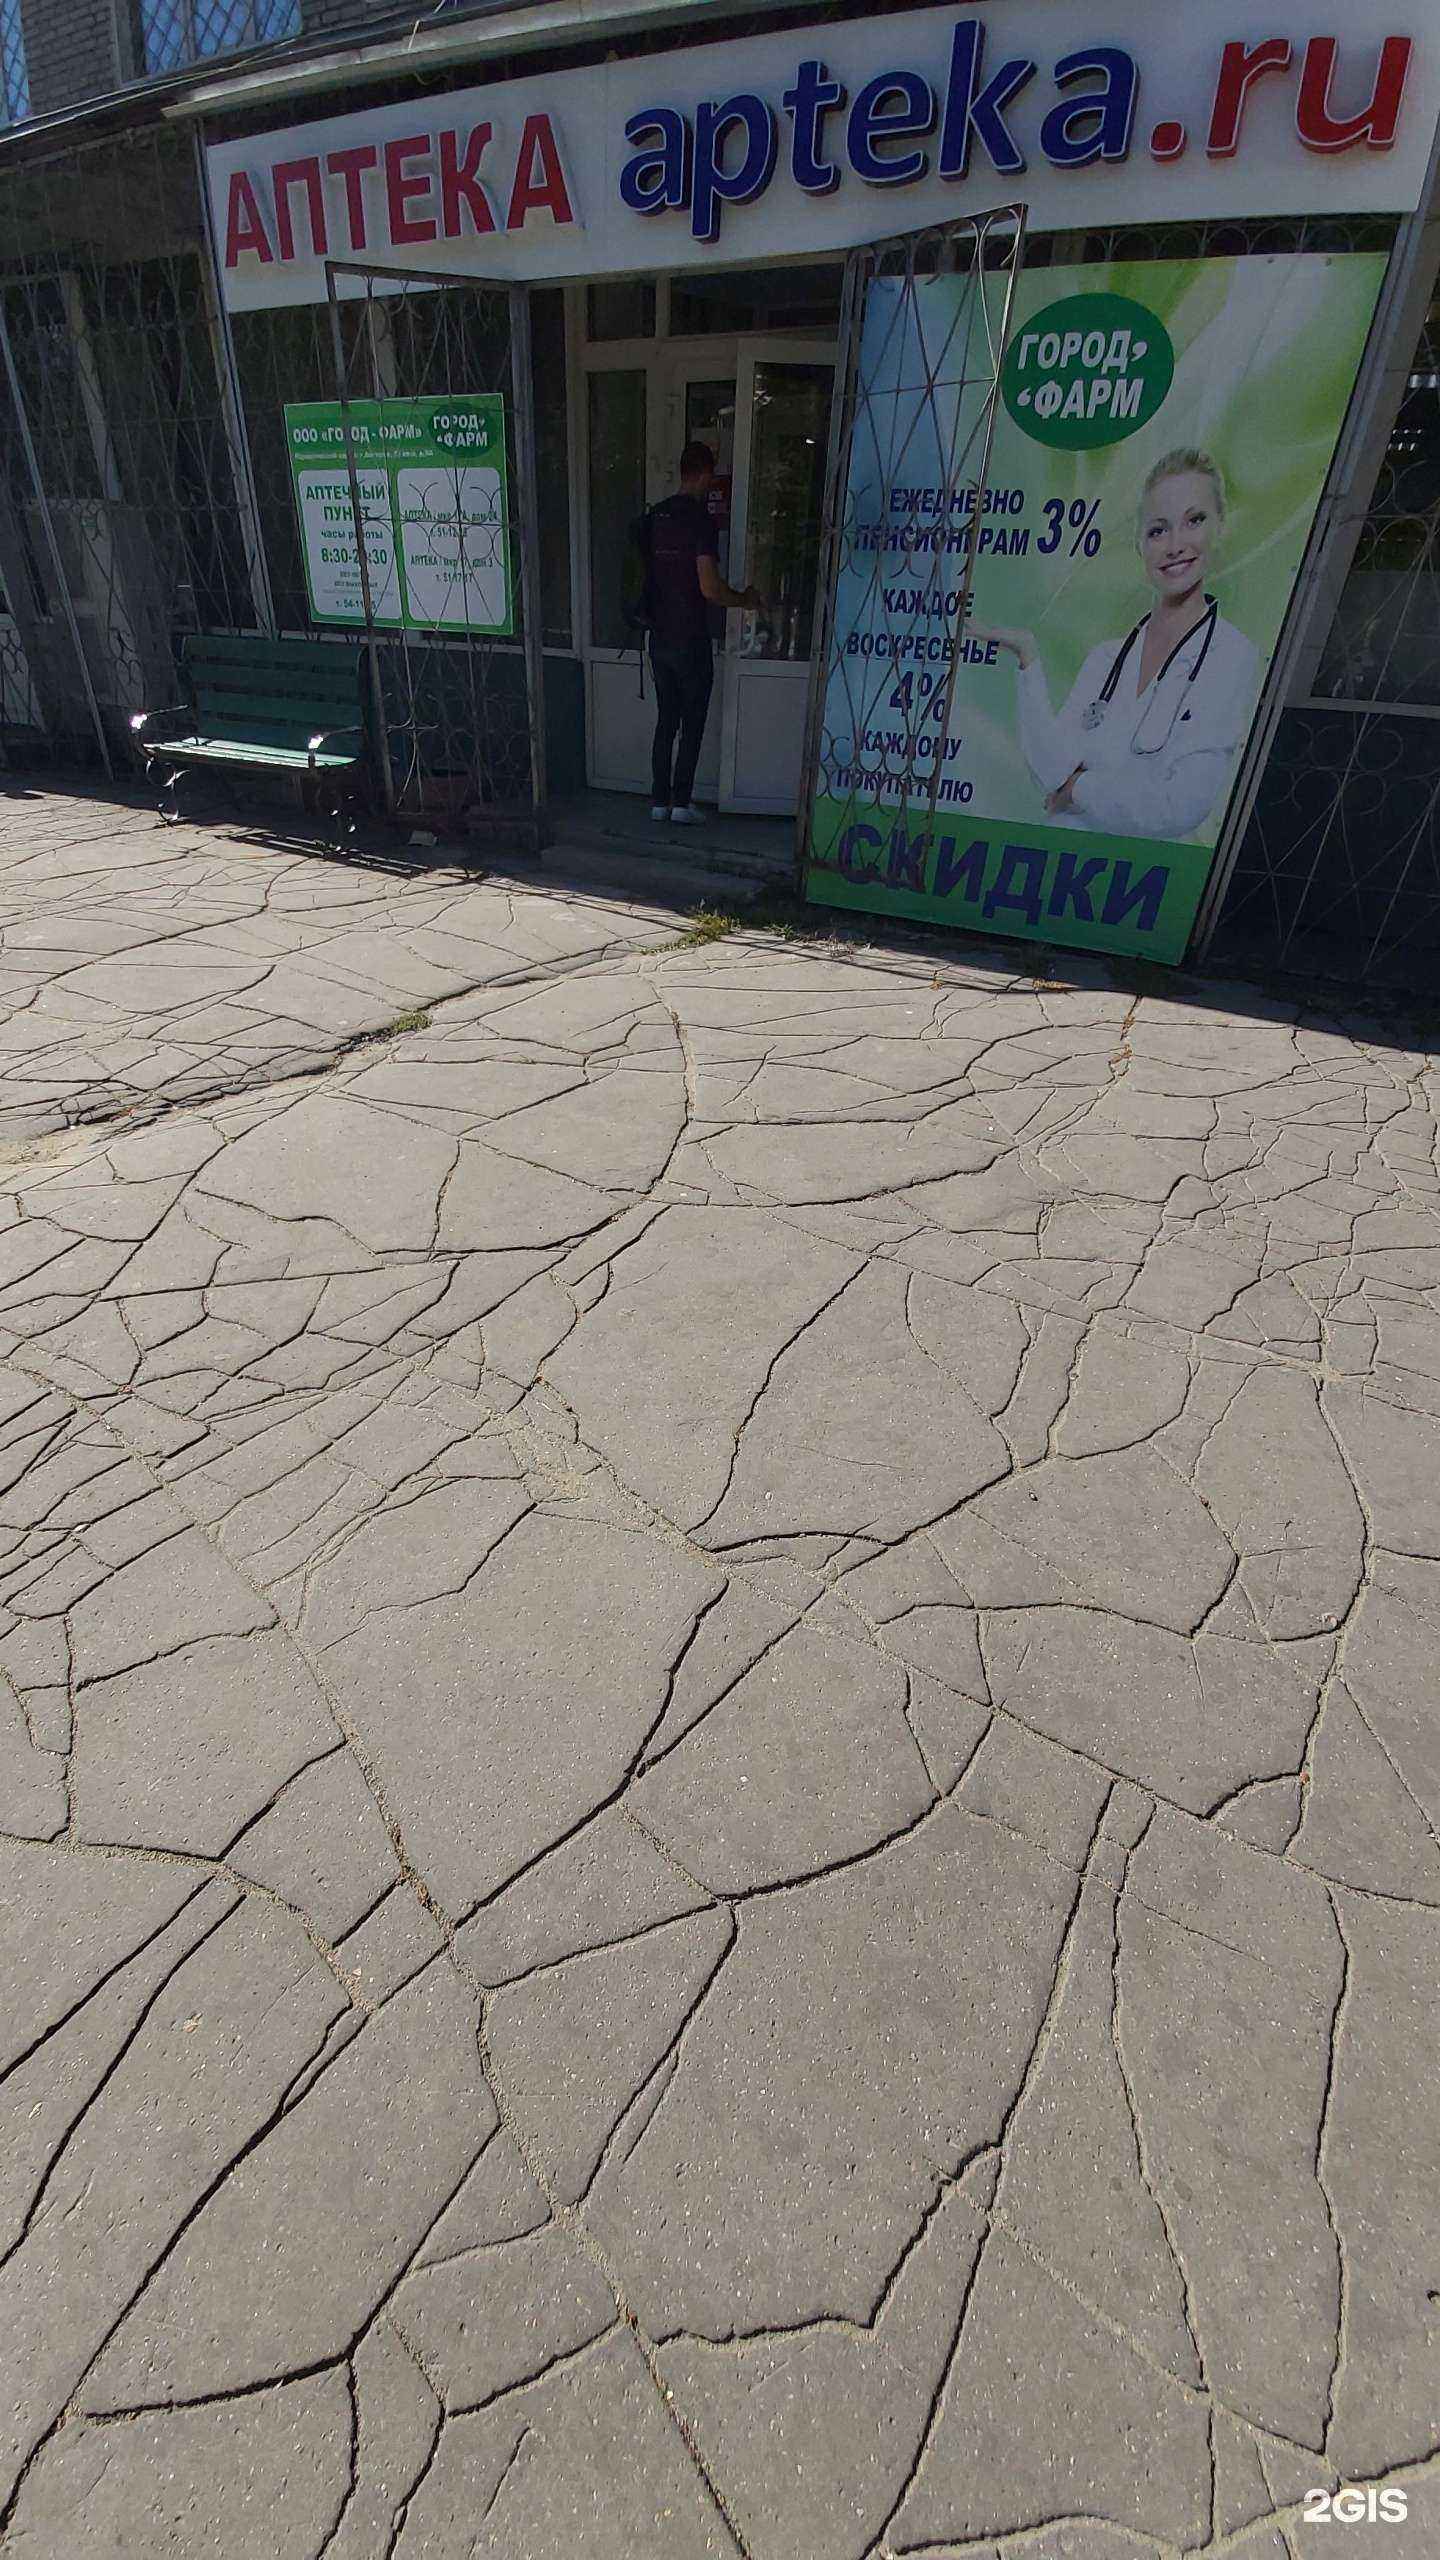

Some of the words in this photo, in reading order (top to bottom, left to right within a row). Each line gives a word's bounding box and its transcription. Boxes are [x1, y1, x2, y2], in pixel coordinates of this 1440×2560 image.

[618, 18, 1413, 244] apteka.ru
[225, 113, 574, 268] АПТЕКА
[293, 428, 319, 443] ООО
[322, 426, 370, 445] «ГООД
[306, 484, 386, 501] АПТЕЧЫЙ
[323, 505, 371, 522] ПУНТ
[1037, 498, 1102, 558] 3%
[321, 547, 388, 566] 8:30-2:30
[838, 824, 1171, 931] СКИДКИ
